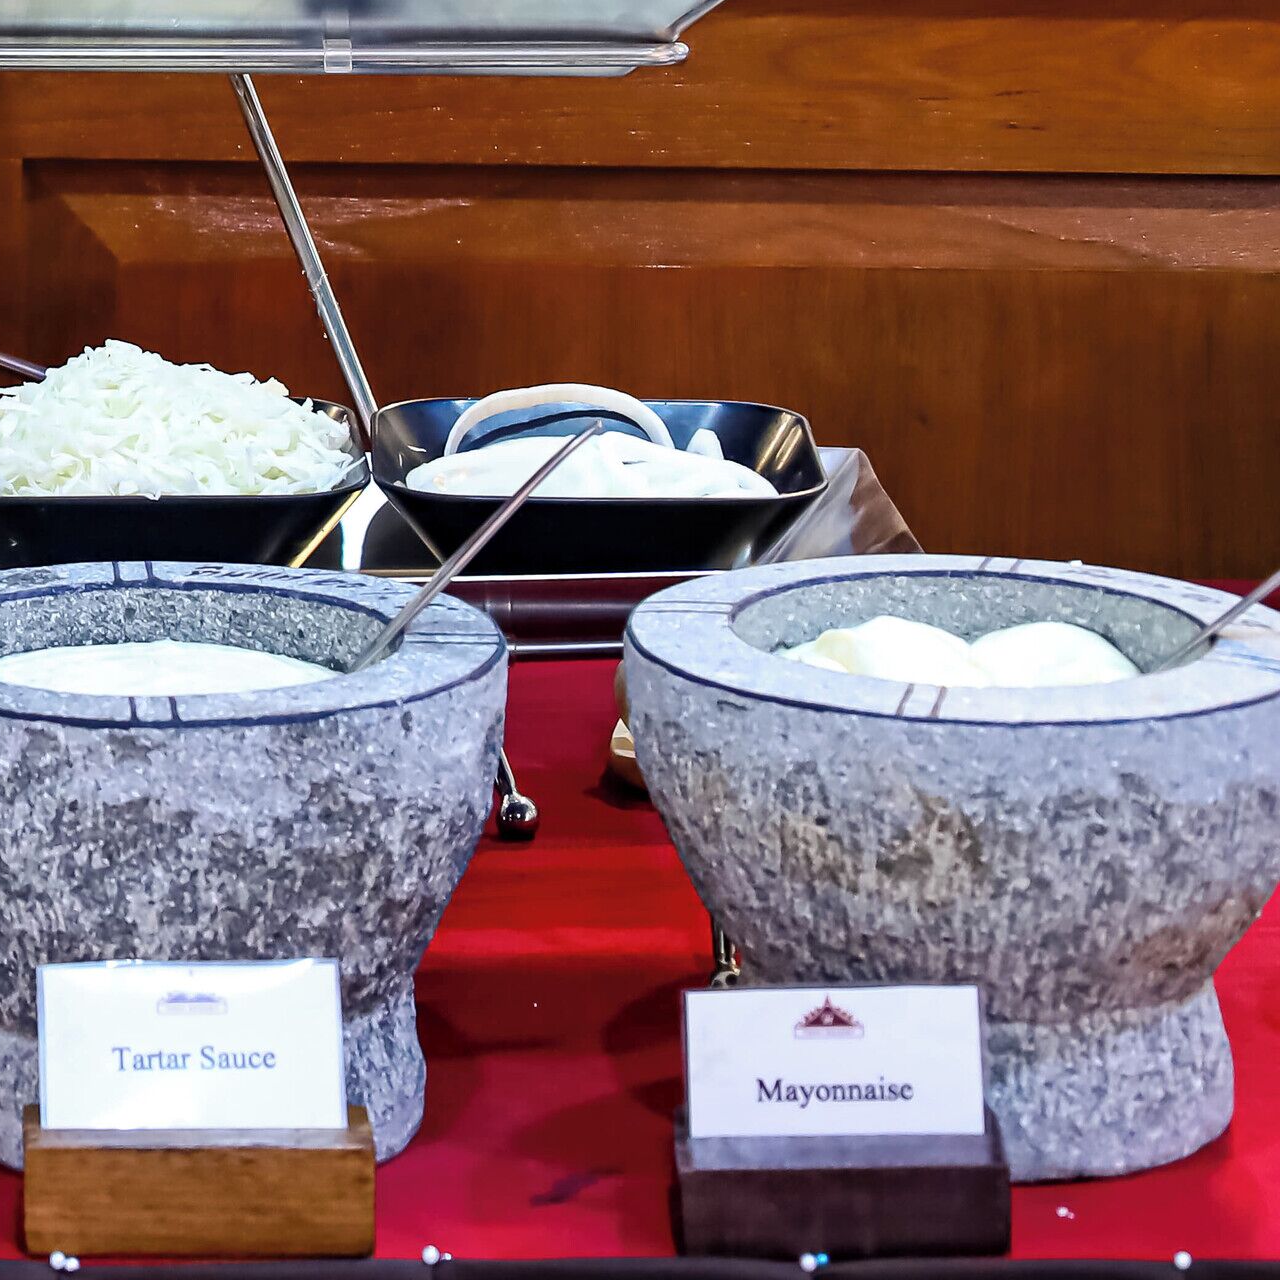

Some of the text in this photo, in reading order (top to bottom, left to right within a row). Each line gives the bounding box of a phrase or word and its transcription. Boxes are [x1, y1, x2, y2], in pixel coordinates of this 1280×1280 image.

[112, 1046, 277, 1072] Tartar Sauce
[755, 1076, 915, 1109] Mayonnaise
